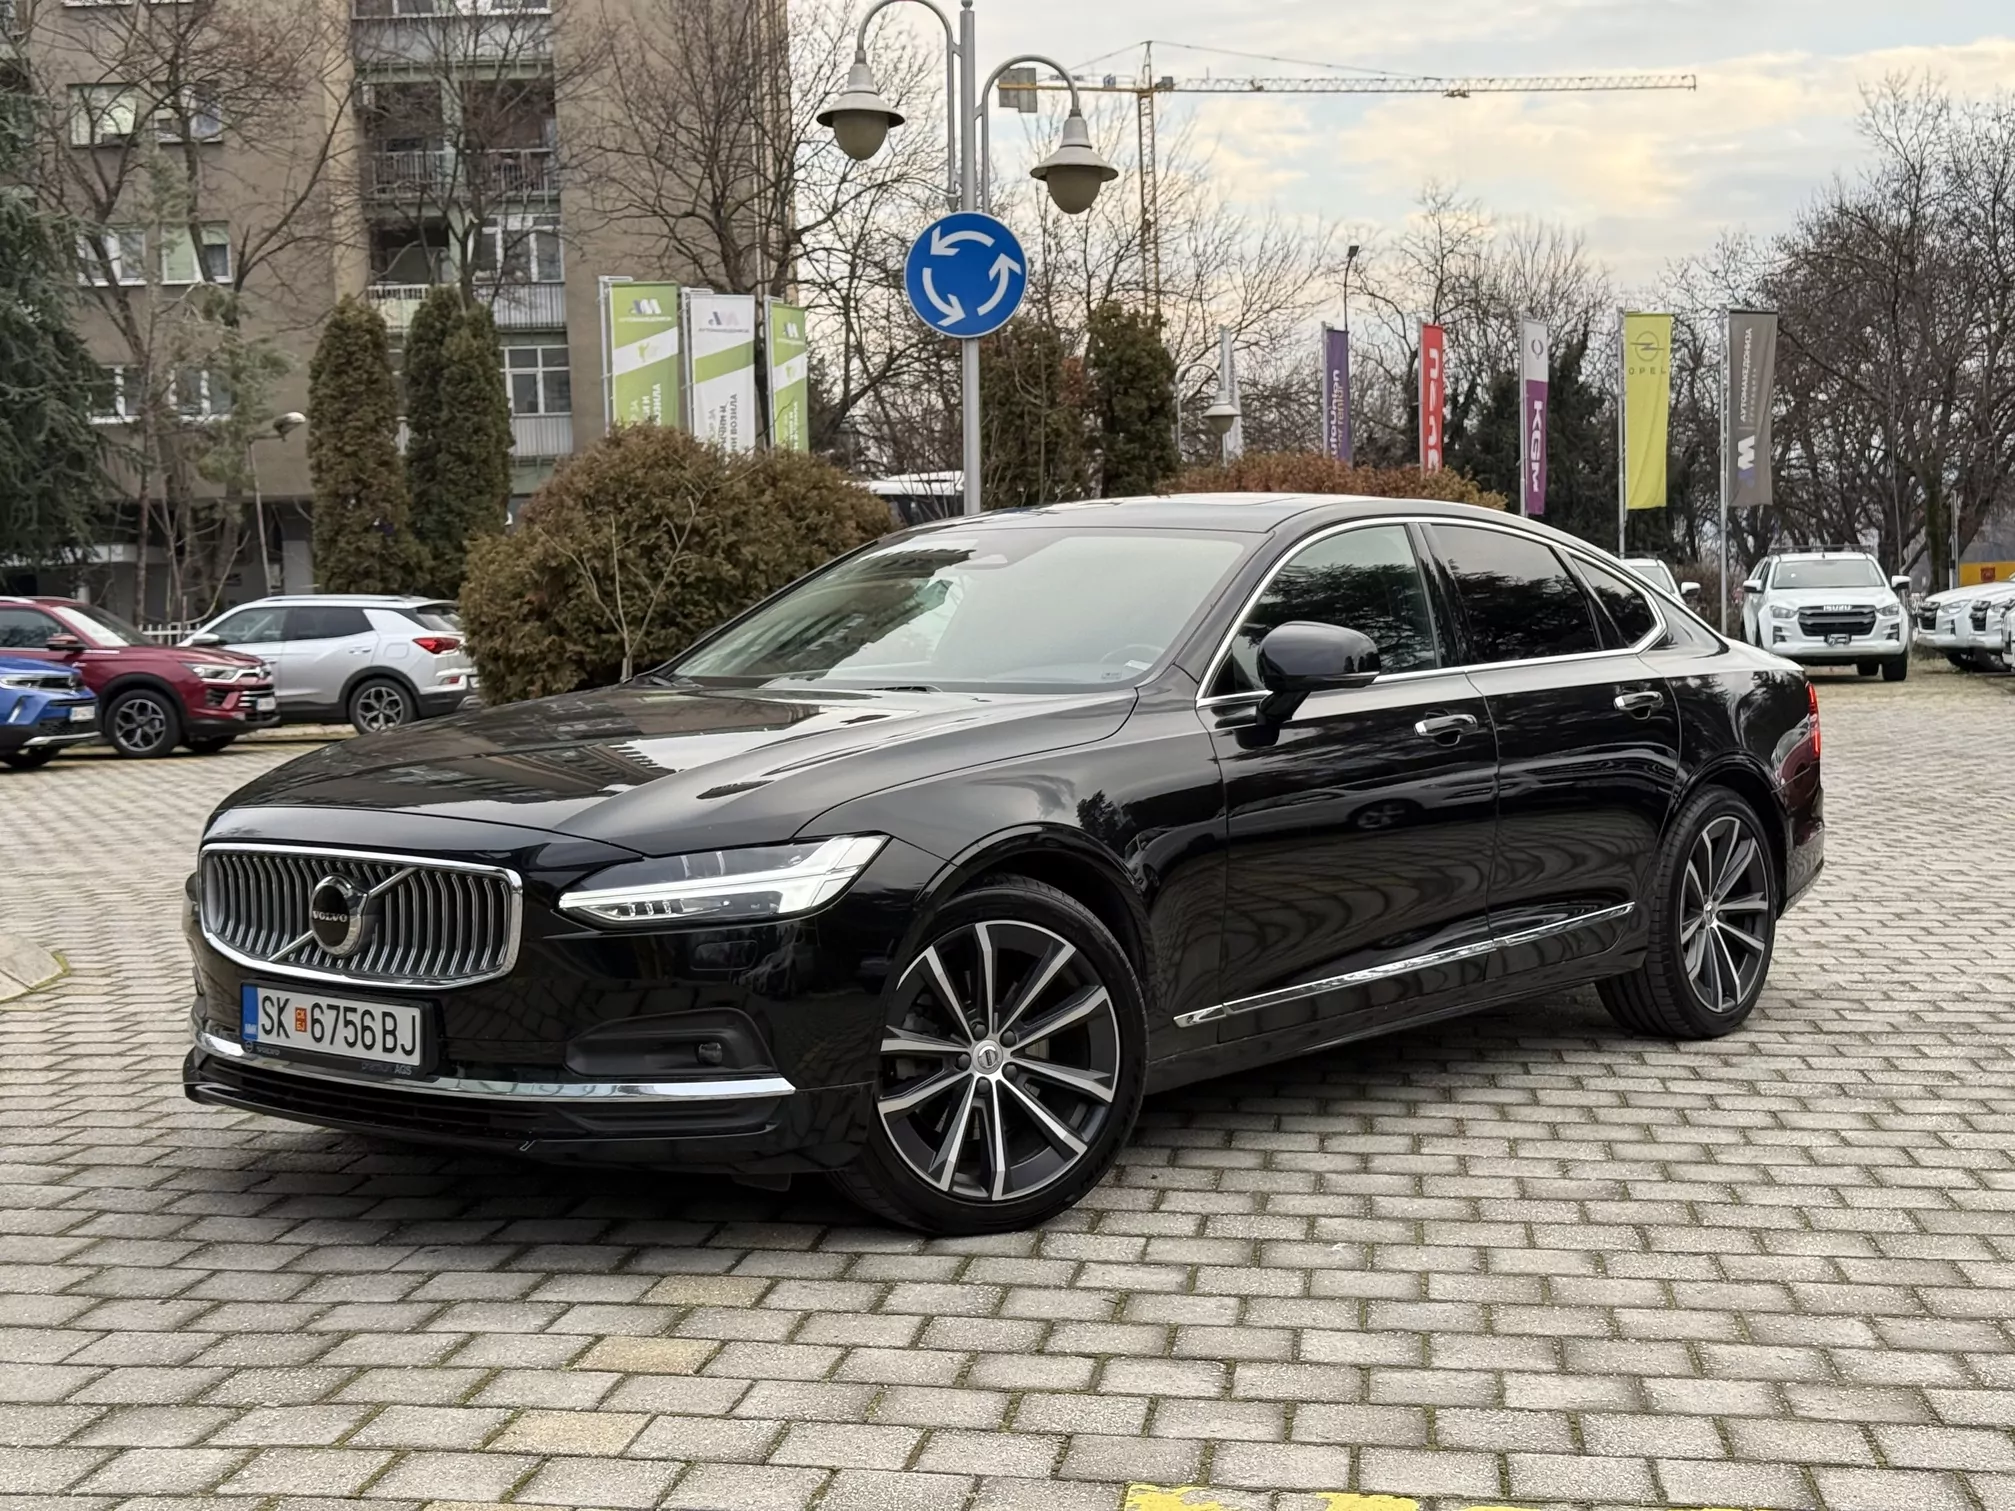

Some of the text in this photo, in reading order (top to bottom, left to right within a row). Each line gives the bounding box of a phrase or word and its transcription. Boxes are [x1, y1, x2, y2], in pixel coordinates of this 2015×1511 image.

[1628, 366, 1667, 376] OPEL
[730, 394, 738, 435] ВОЗИЛА
[1330, 369, 1341, 457] utoUnion
[1530, 400, 1544, 493] KGM
[312, 910, 348, 923] VOLVO
[261, 994, 291, 1040] SK
